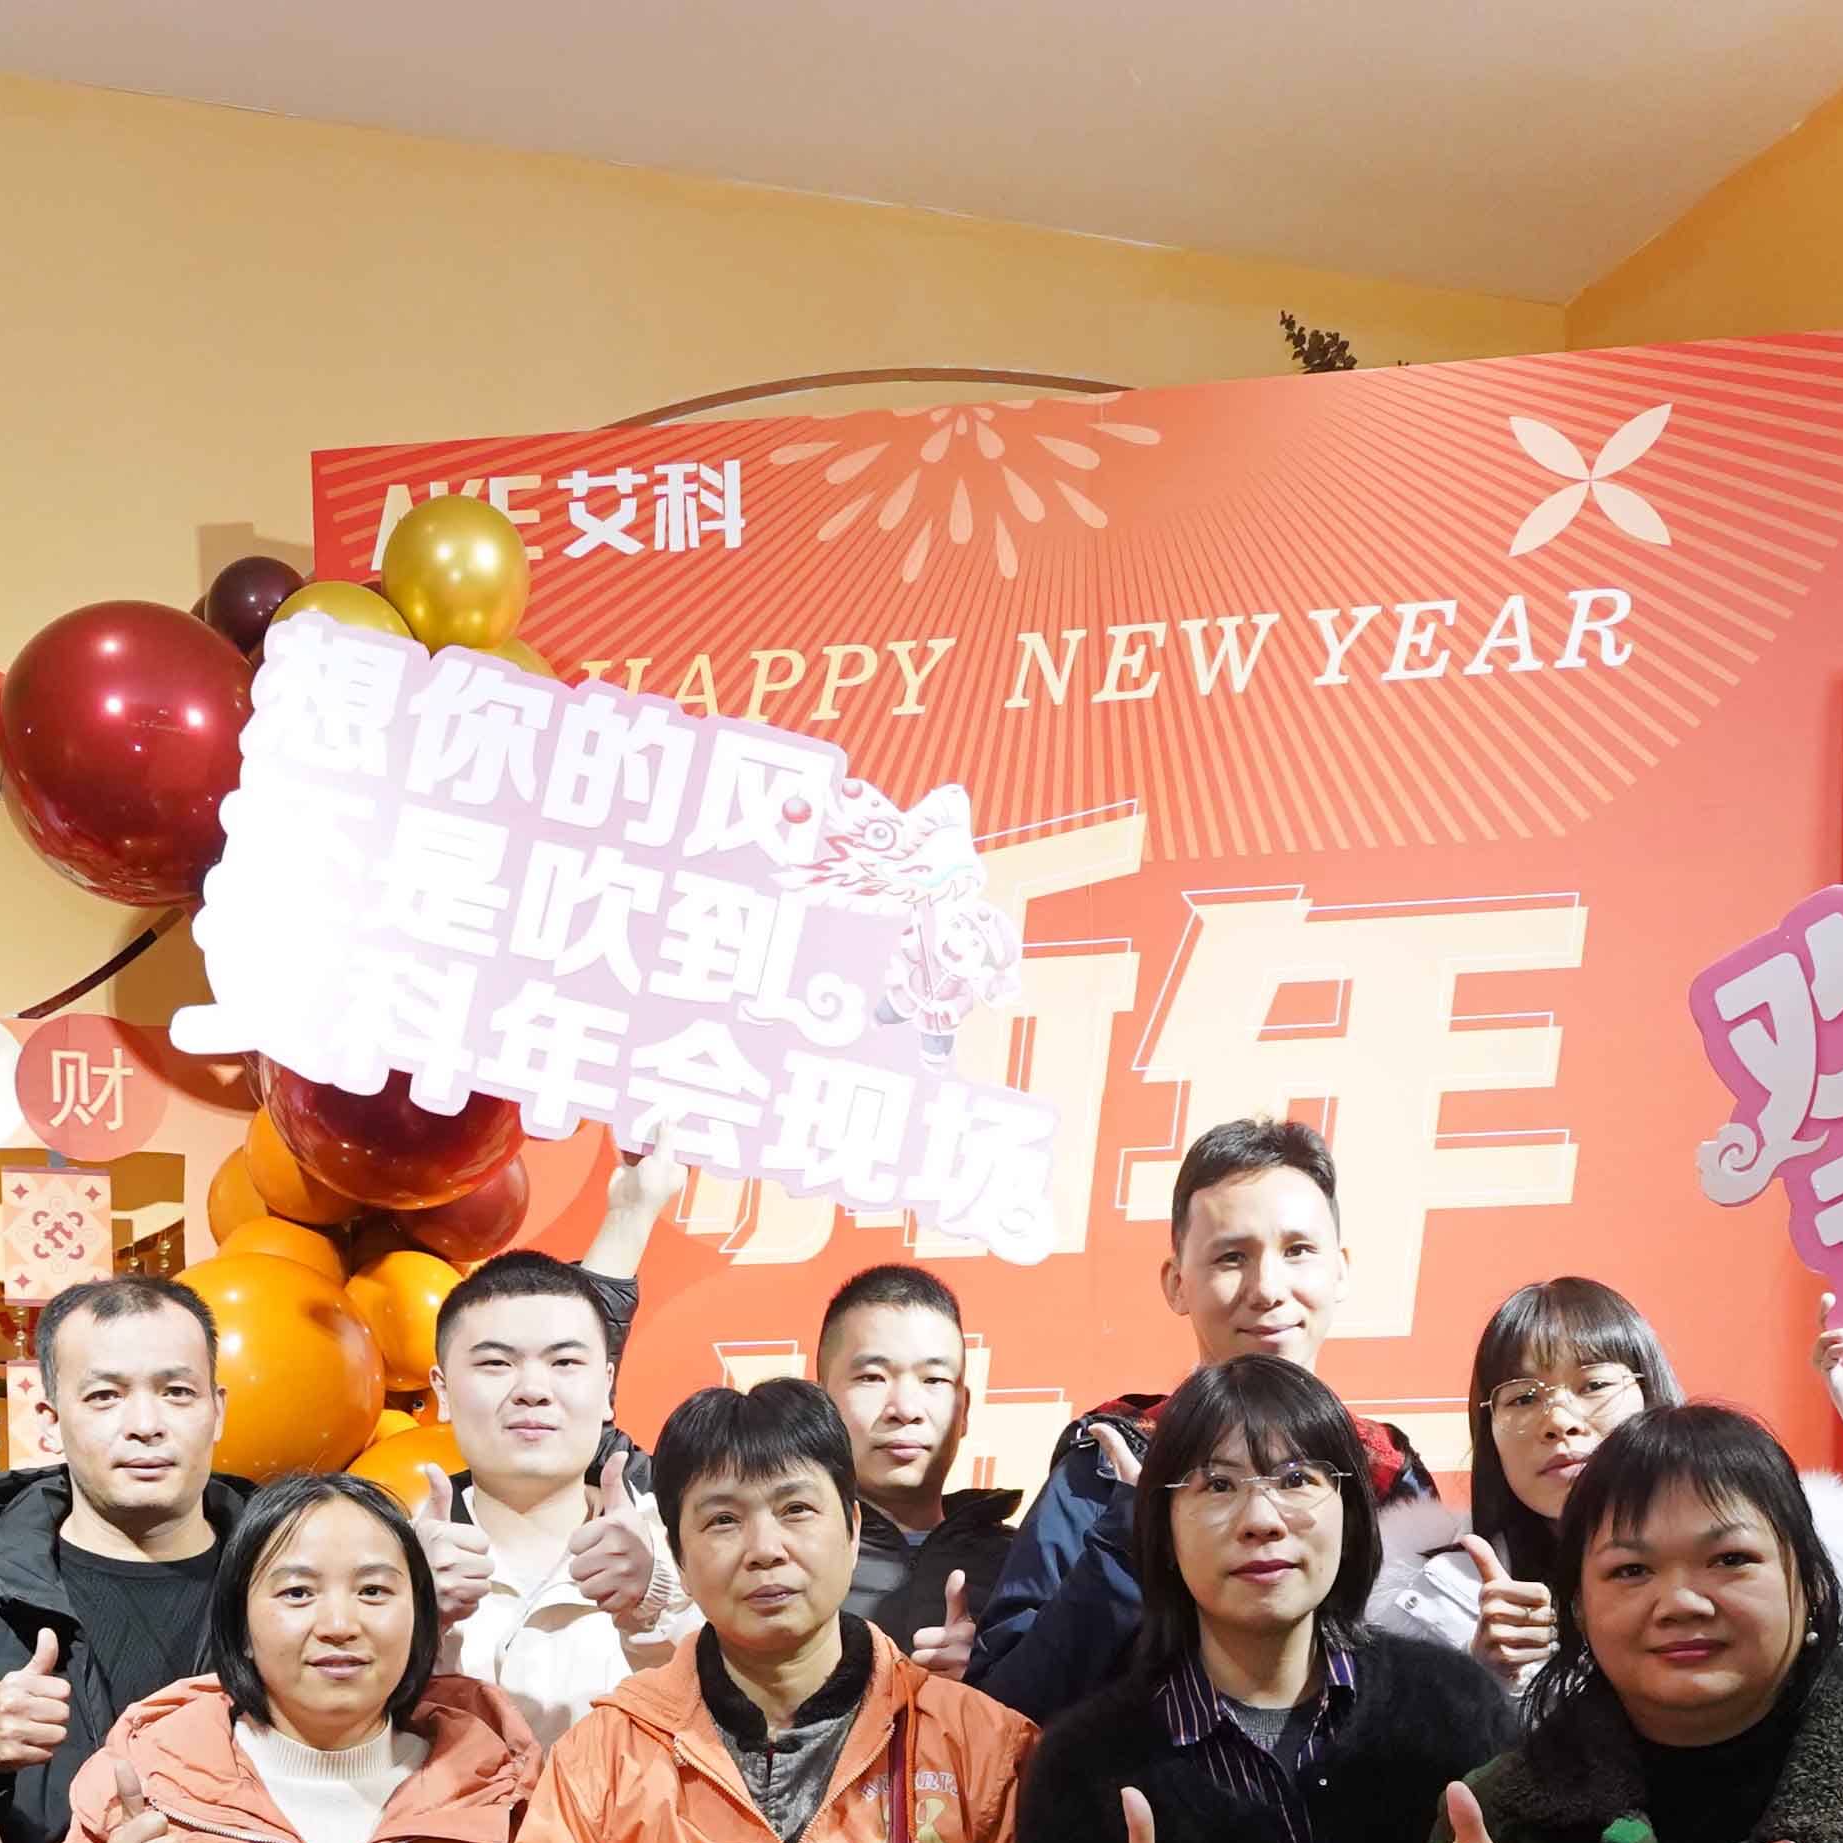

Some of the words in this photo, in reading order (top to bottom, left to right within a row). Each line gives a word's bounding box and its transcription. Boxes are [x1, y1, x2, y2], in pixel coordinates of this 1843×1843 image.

[557, 459, 746, 559] 艾科
[1004, 612, 1280, 709] NEW
[1306, 587, 1634, 685] YEAR
[267, 625, 839, 866] 想你的风
